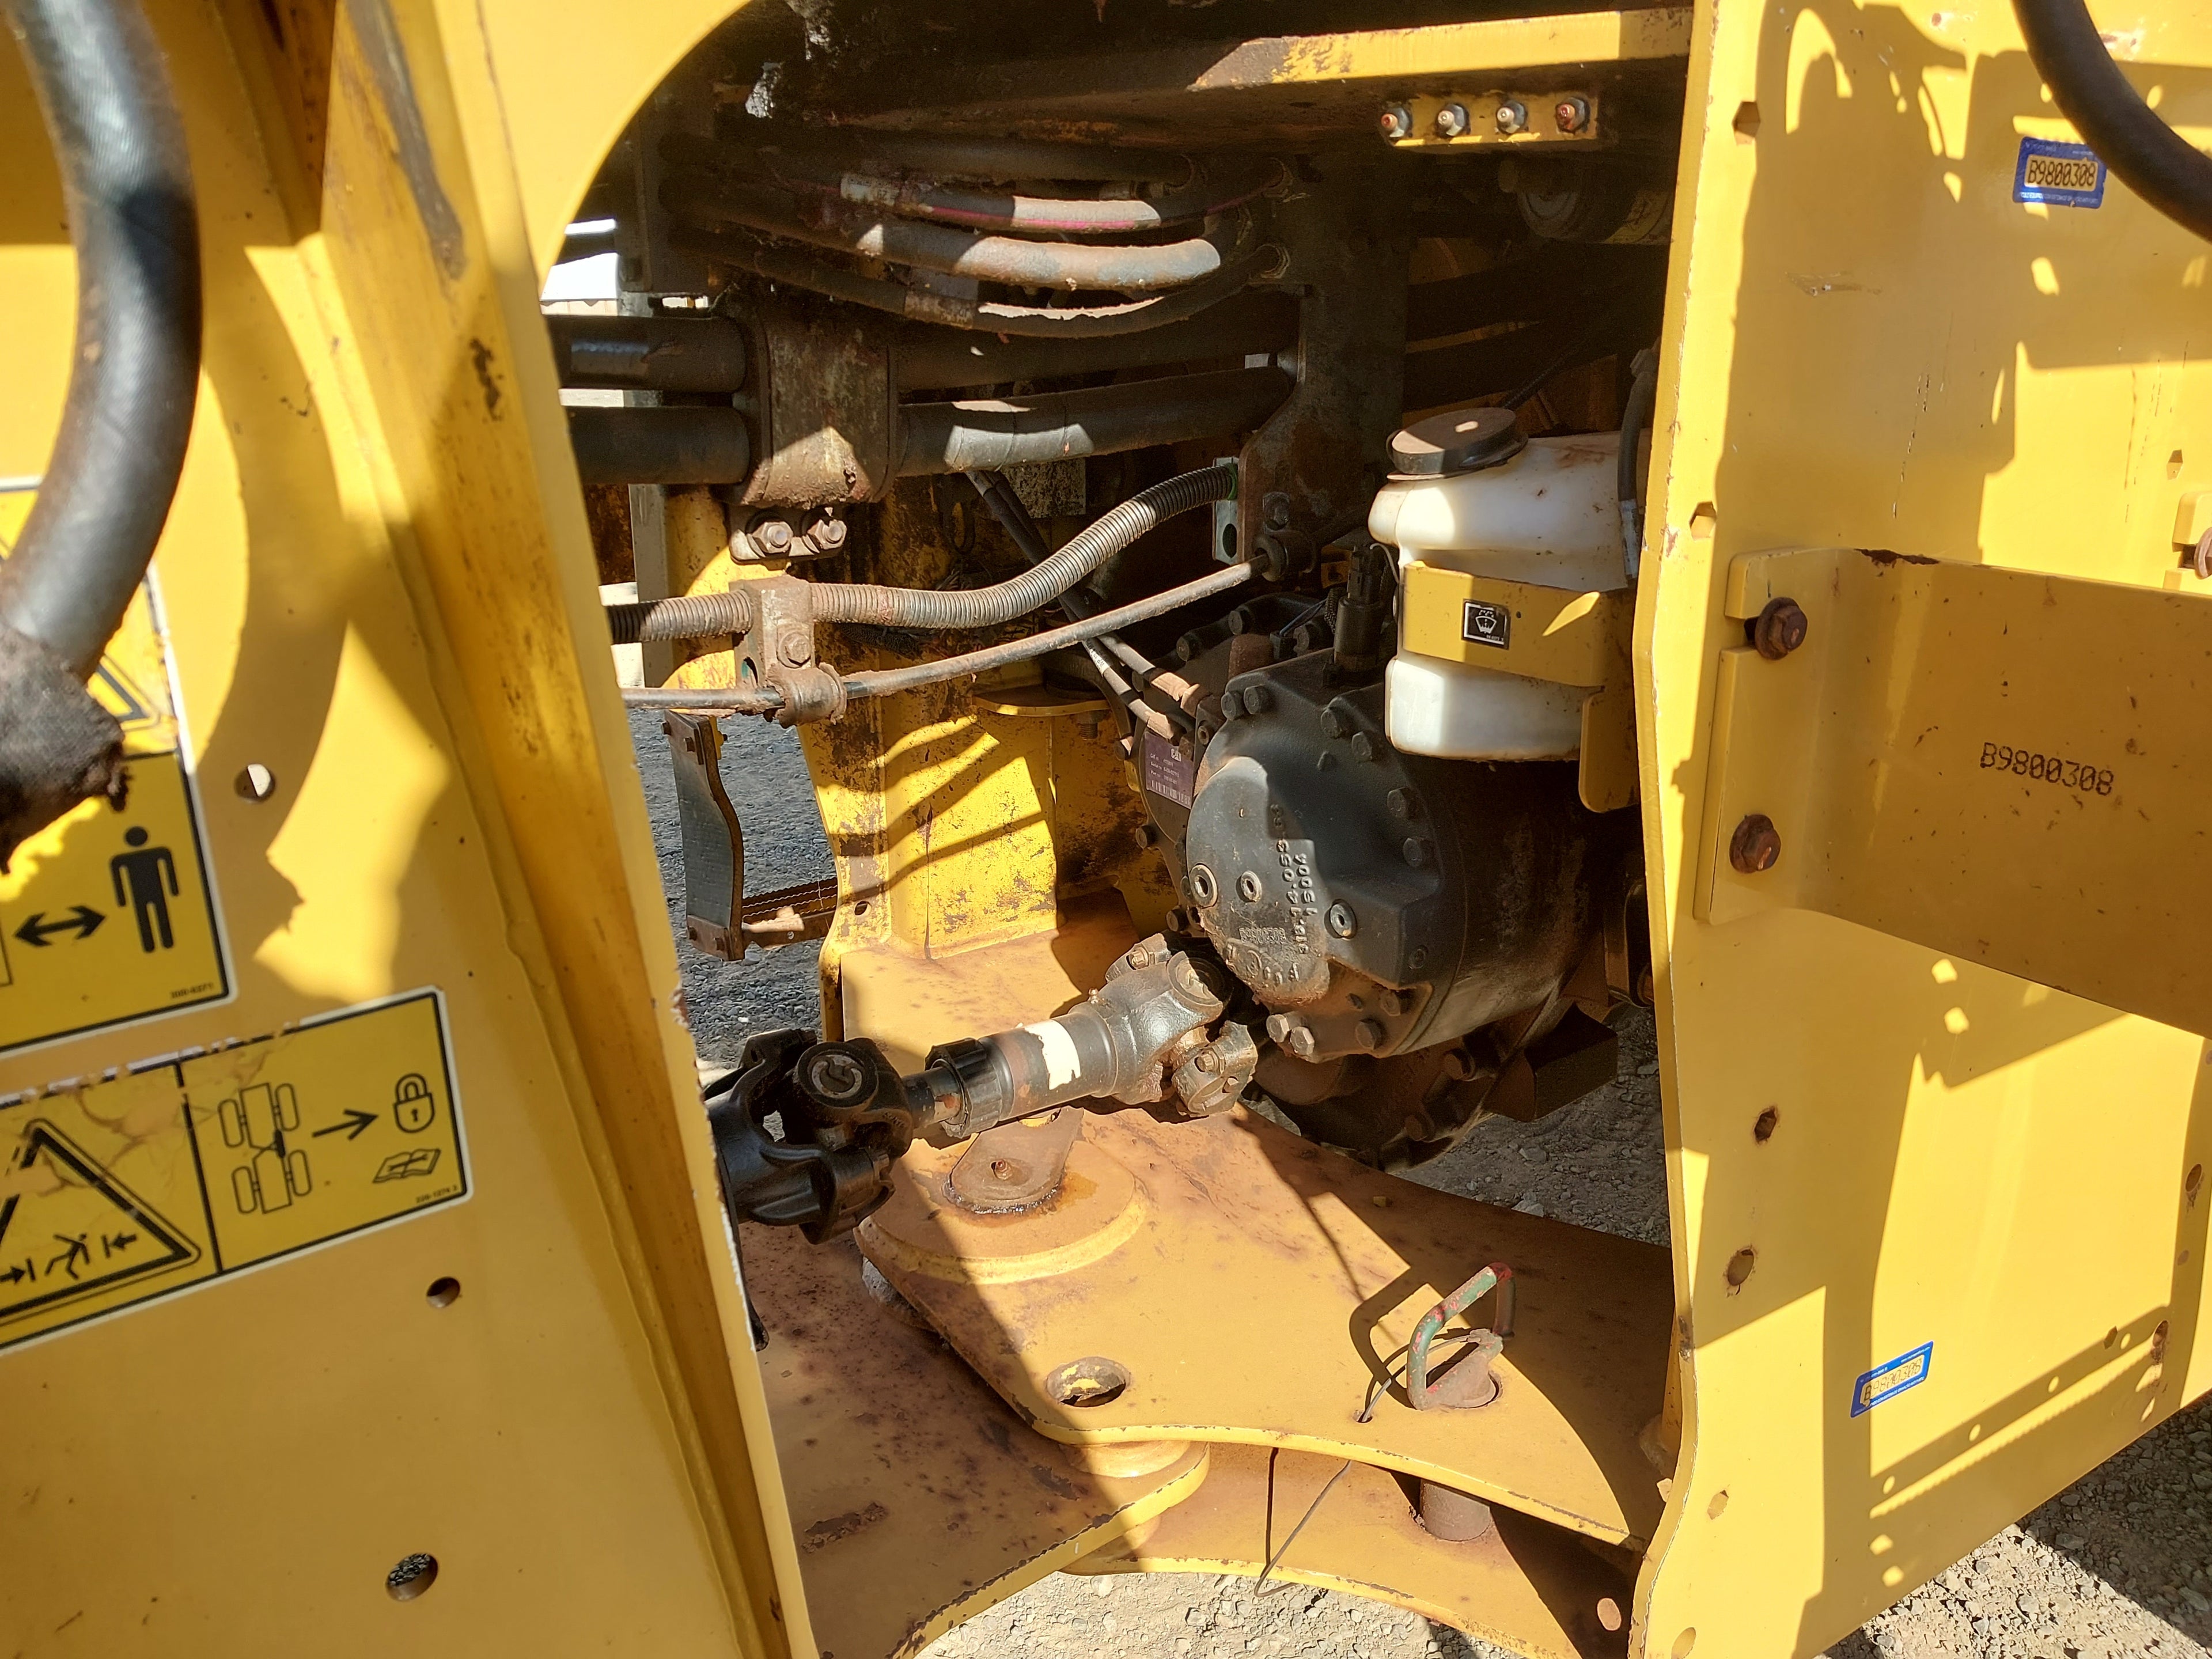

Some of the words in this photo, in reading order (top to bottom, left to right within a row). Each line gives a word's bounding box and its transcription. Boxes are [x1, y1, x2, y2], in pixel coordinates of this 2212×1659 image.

[2027, 160, 2096, 187] B9800308
[1171, 748, 1181, 762] CAT
[1979, 742, 2114, 796] B9800308
